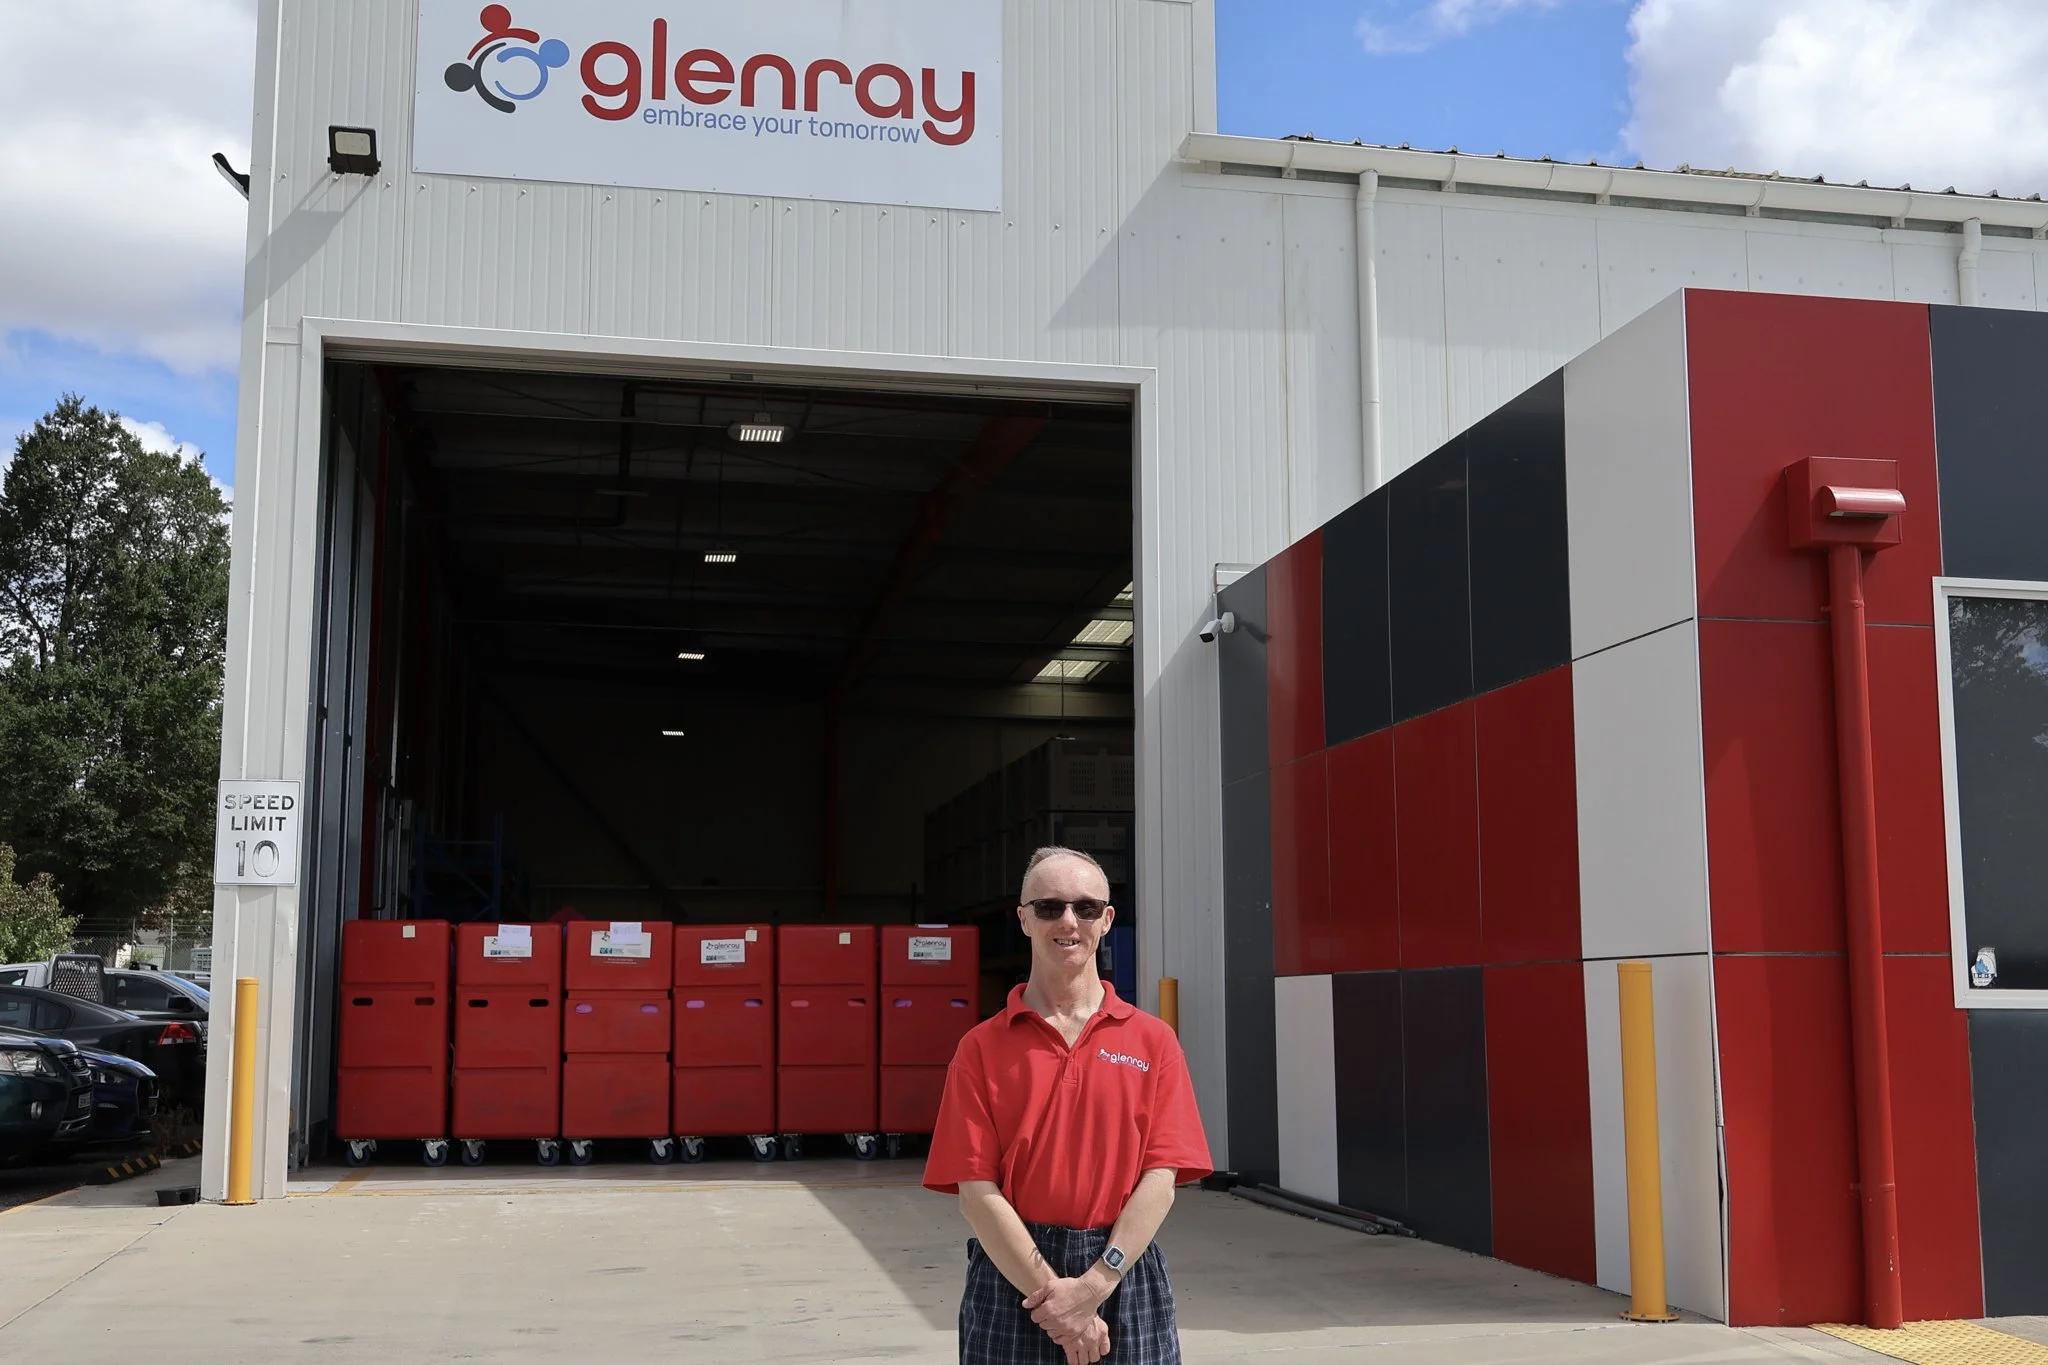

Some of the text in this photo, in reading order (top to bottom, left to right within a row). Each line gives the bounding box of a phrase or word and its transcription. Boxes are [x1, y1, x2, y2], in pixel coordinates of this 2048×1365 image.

[580, 17, 976, 147] glenray
[643, 103, 921, 145] embrace your tomorrow
[224, 794, 295, 811] SPEED
[231, 815, 287, 832] LIMIT
[235, 840, 280, 878] 10
[1110, 1052, 1150, 1072] glenray
